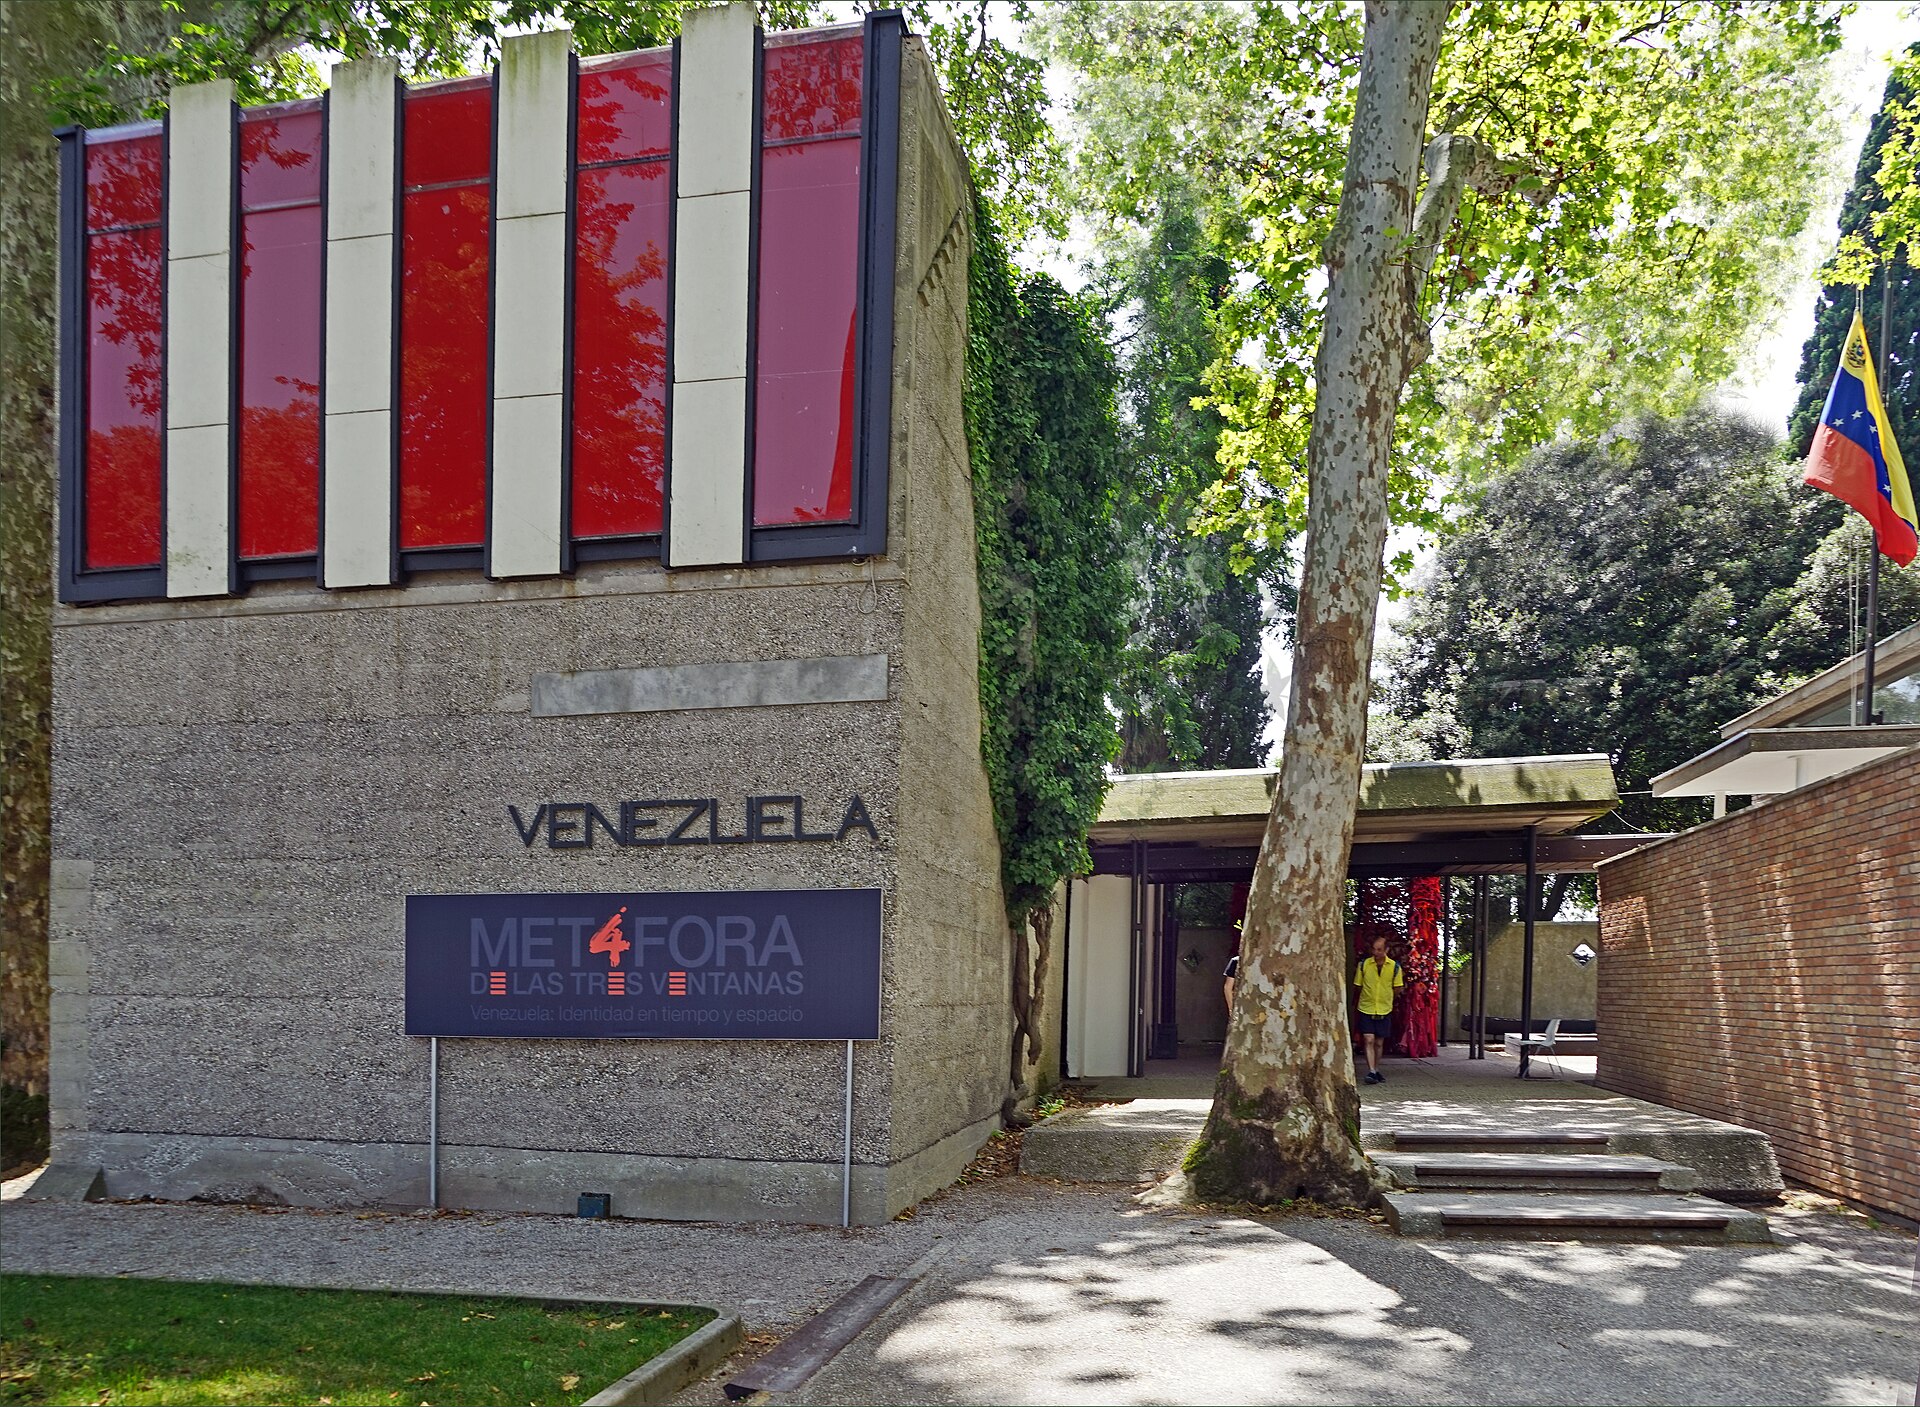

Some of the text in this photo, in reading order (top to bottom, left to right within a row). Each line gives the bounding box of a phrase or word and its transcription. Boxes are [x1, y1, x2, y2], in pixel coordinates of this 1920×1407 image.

[508, 794, 880, 849] VENEZUELA
[470, 970, 804, 996] DE LAS TRES VENTANAS
[470, 1004, 804, 1026] Venezuela: Identidad en tiempo y espacio
